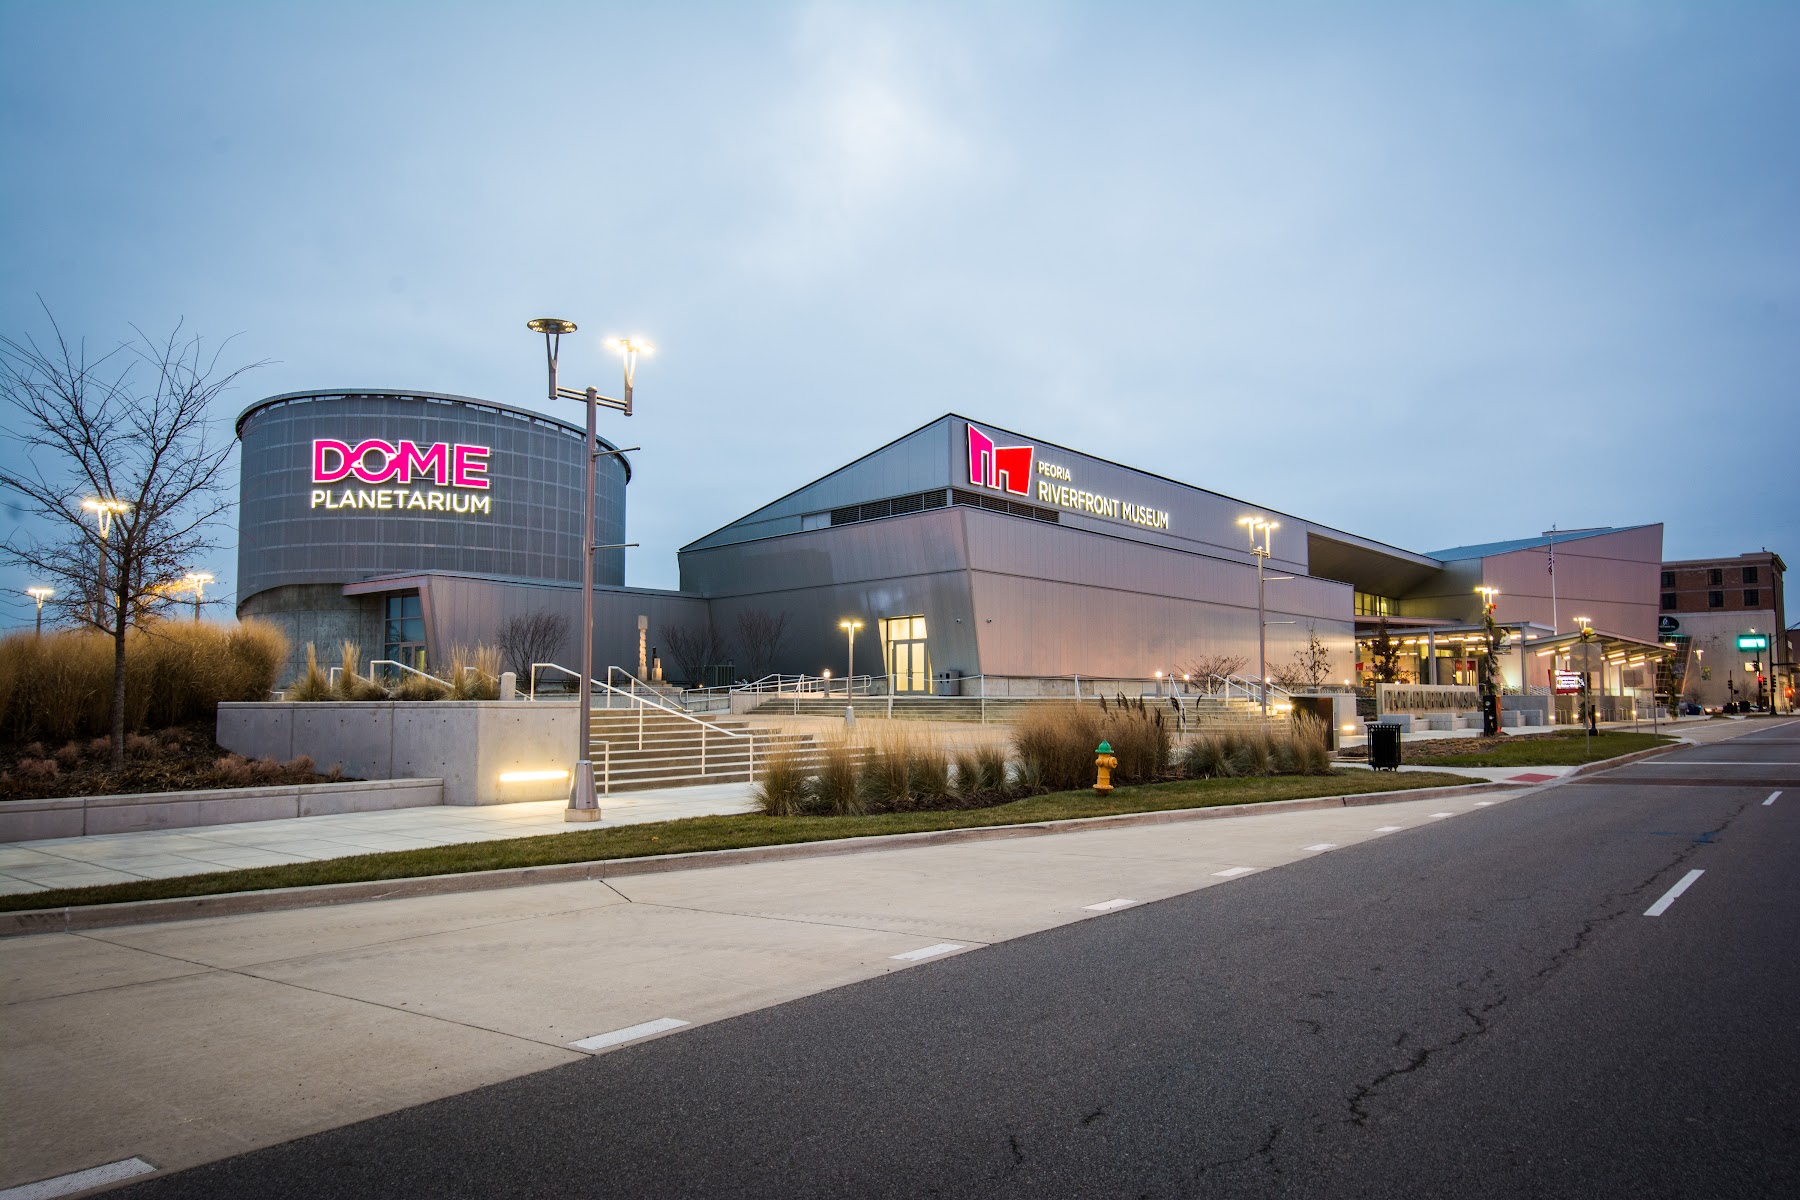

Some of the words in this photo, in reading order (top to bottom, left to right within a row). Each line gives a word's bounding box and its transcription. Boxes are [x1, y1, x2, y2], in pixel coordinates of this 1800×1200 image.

[312, 438, 490, 489] DOME
[1038, 460, 1071, 481] PEORIA
[311, 489, 490, 514] PLANETARIUM
[1038, 480, 1119, 518] RIVERFRONT
[1121, 501, 1169, 530] MUSEUM
